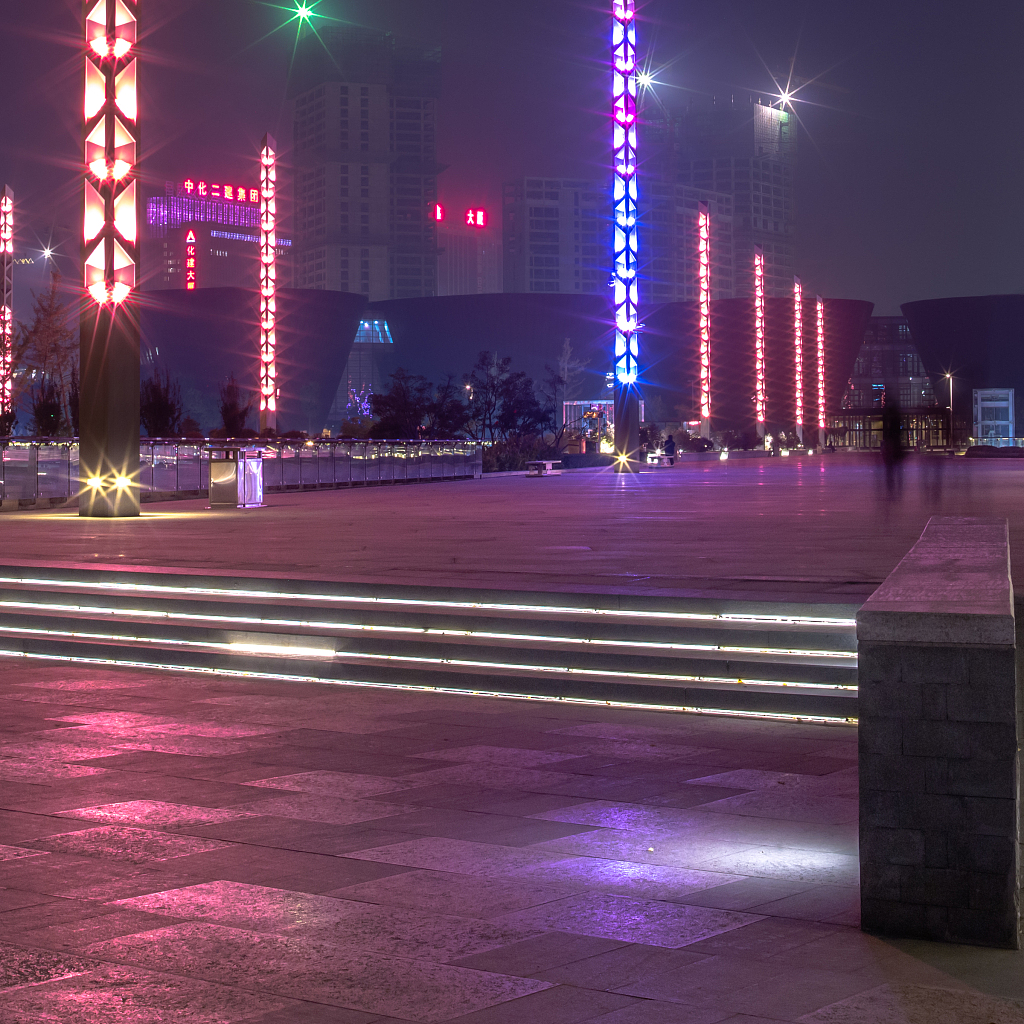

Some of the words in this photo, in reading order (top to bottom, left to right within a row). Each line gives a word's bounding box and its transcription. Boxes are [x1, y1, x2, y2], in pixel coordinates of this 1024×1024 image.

[184, 179, 259, 203] 中化二建集团
